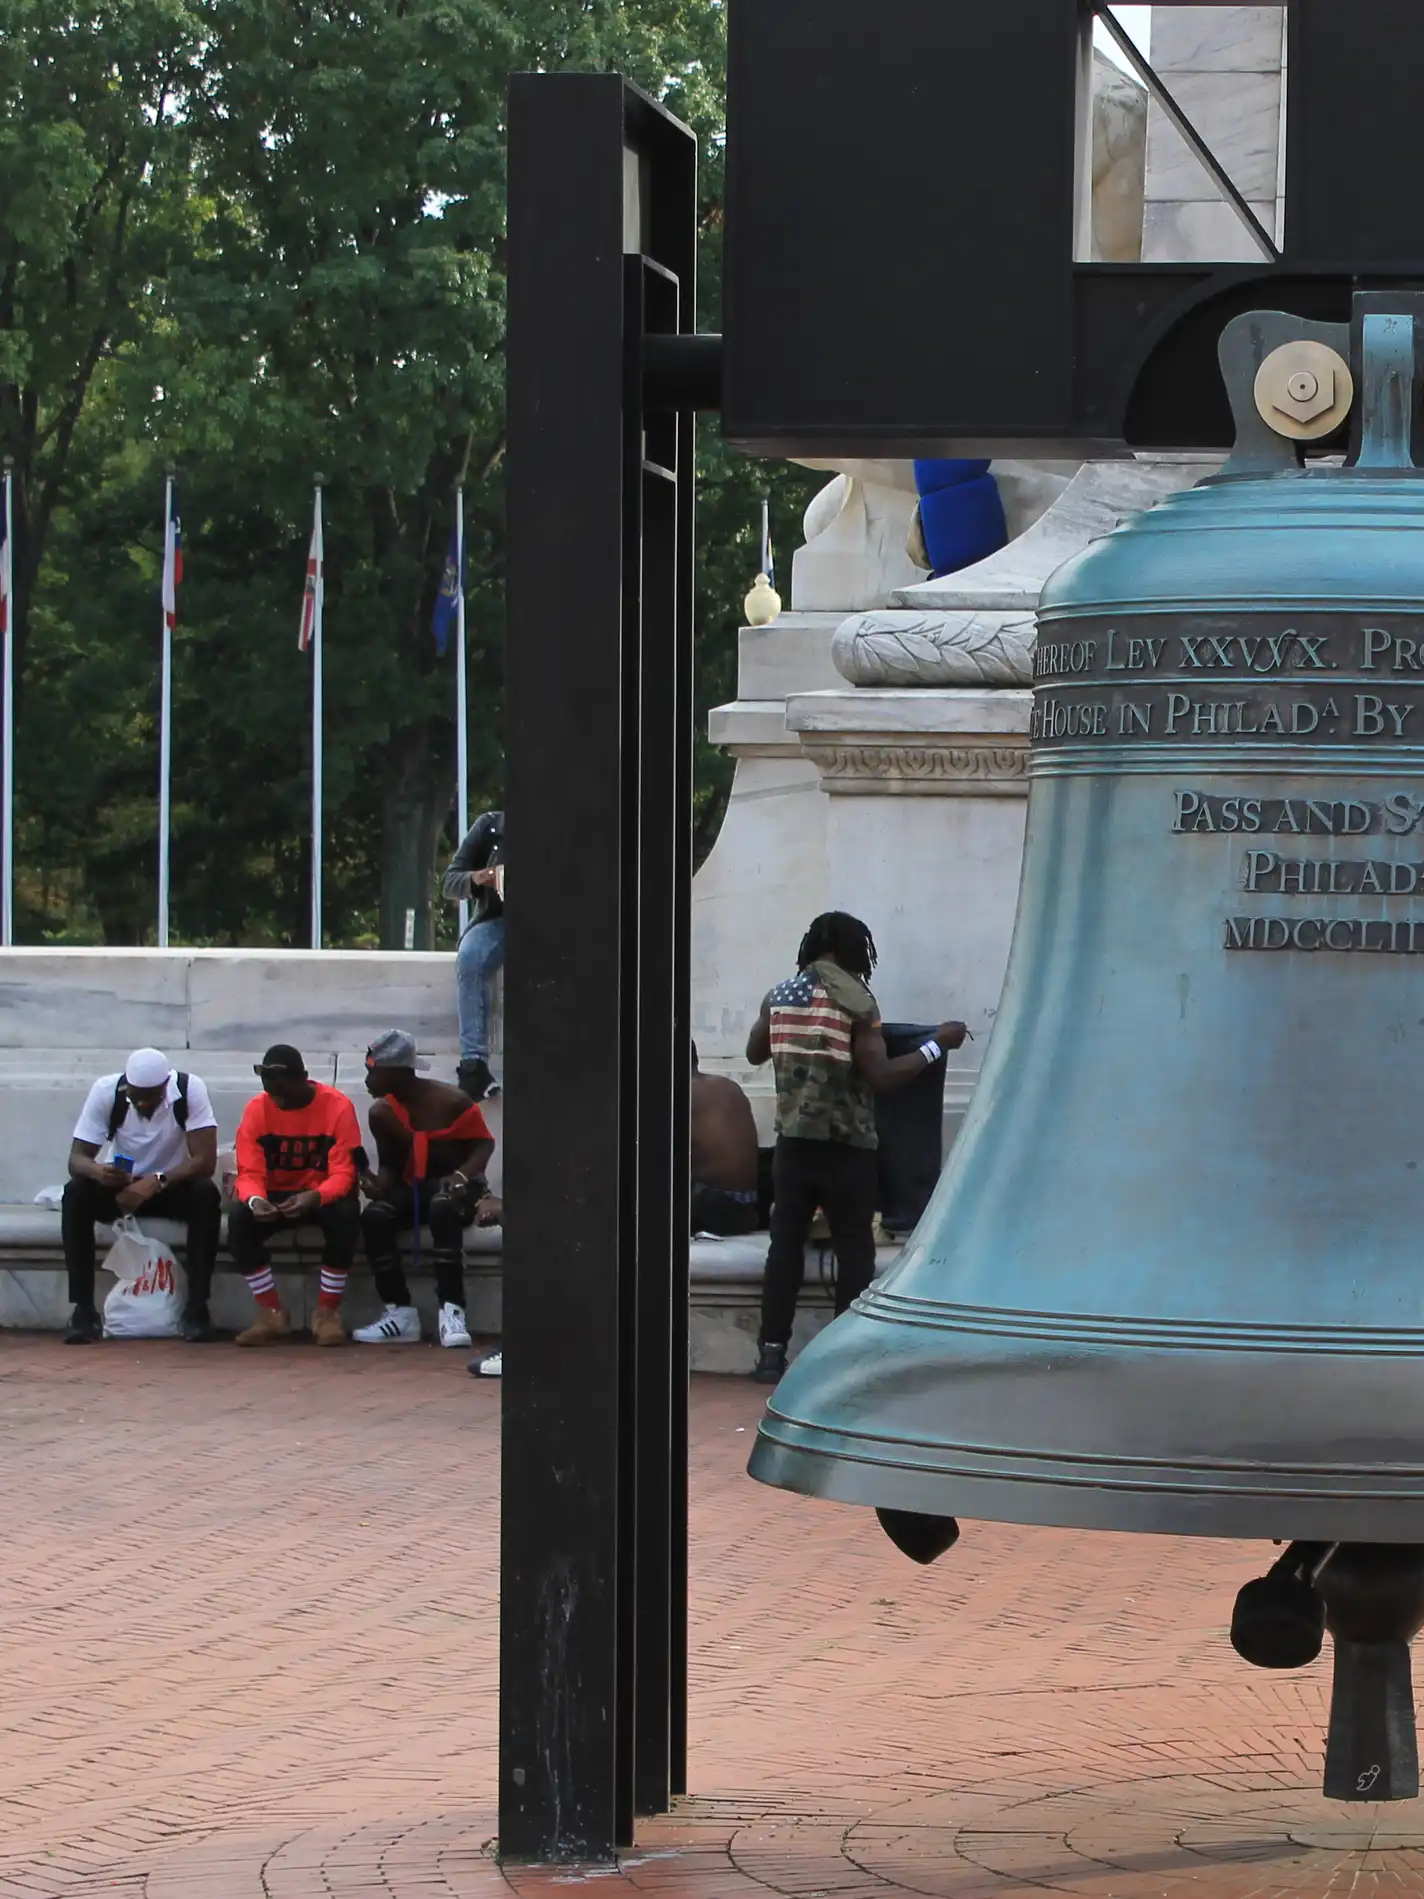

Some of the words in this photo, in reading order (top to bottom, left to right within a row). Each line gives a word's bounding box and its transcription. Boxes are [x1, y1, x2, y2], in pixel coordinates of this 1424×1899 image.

[1105, 629, 1167, 670] LEV
[1042, 699, 1107, 738] HOUSE
[1117, 702, 1153, 734] IN
[1352, 693, 1415, 737] BY
[1172, 789, 1262, 833] PASS
[1272, 798, 1371, 834] AND
